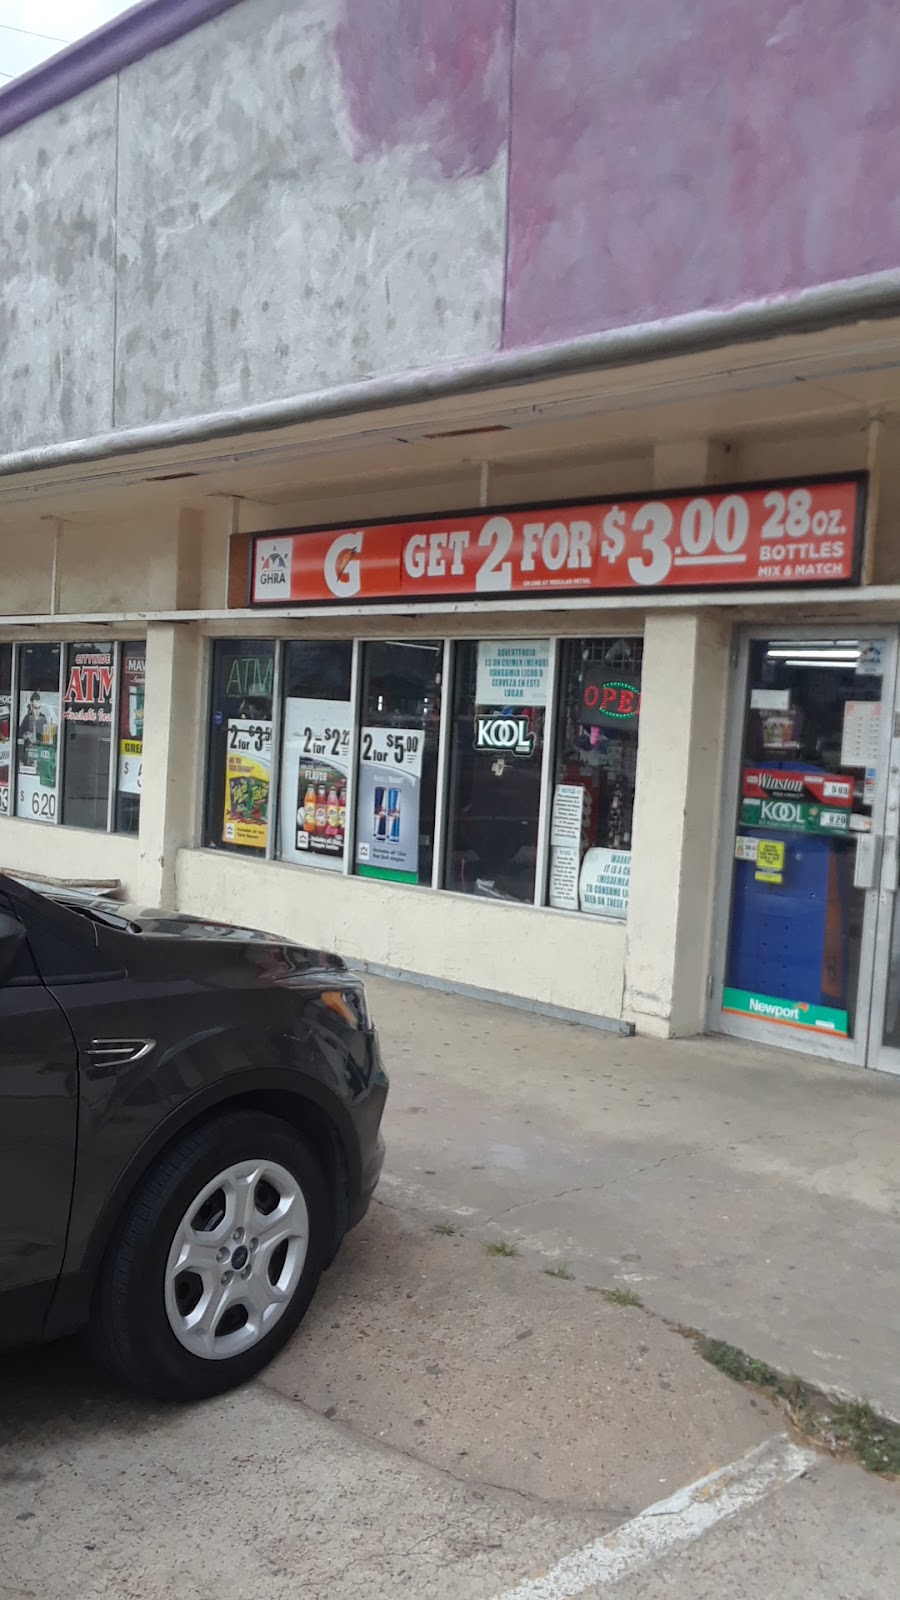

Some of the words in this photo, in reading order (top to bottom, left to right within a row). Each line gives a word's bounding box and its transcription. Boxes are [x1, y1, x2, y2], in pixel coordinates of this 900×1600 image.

[404, 530, 471, 579] GET
[475, 515, 514, 592] 2
[520, 520, 592, 571] FOR
[601, 495, 750, 586] $3.00
[760, 541, 844, 564] BOTTLES
[323, 531, 364, 598] G
[758, 565, 781, 578] MIX
[783, 565, 794, 577] &
[796, 562, 844, 576] MATCH
[260, 572, 287, 585] GHRA
[63, 665, 114, 703] ATM
[226, 657, 274, 694] ATM
[584, 685, 642, 715] OPE
[239, 738, 250, 750] for
[303, 726, 313, 753] 2
[313, 742, 327, 754] for
[477, 718, 531, 748] KOOL
[362, 732, 374, 761] 2
[373, 748, 389, 762] for
[387, 733, 419, 763] $5.00
[304, 769, 328, 782] FLAVOR
[758, 772, 804, 793] Winston
[761, 800, 806, 823] KOOL
[594, 885, 621, 897] CONSUME
[606, 897, 623, 909] THESE
[749, 998, 800, 1020] Newport
